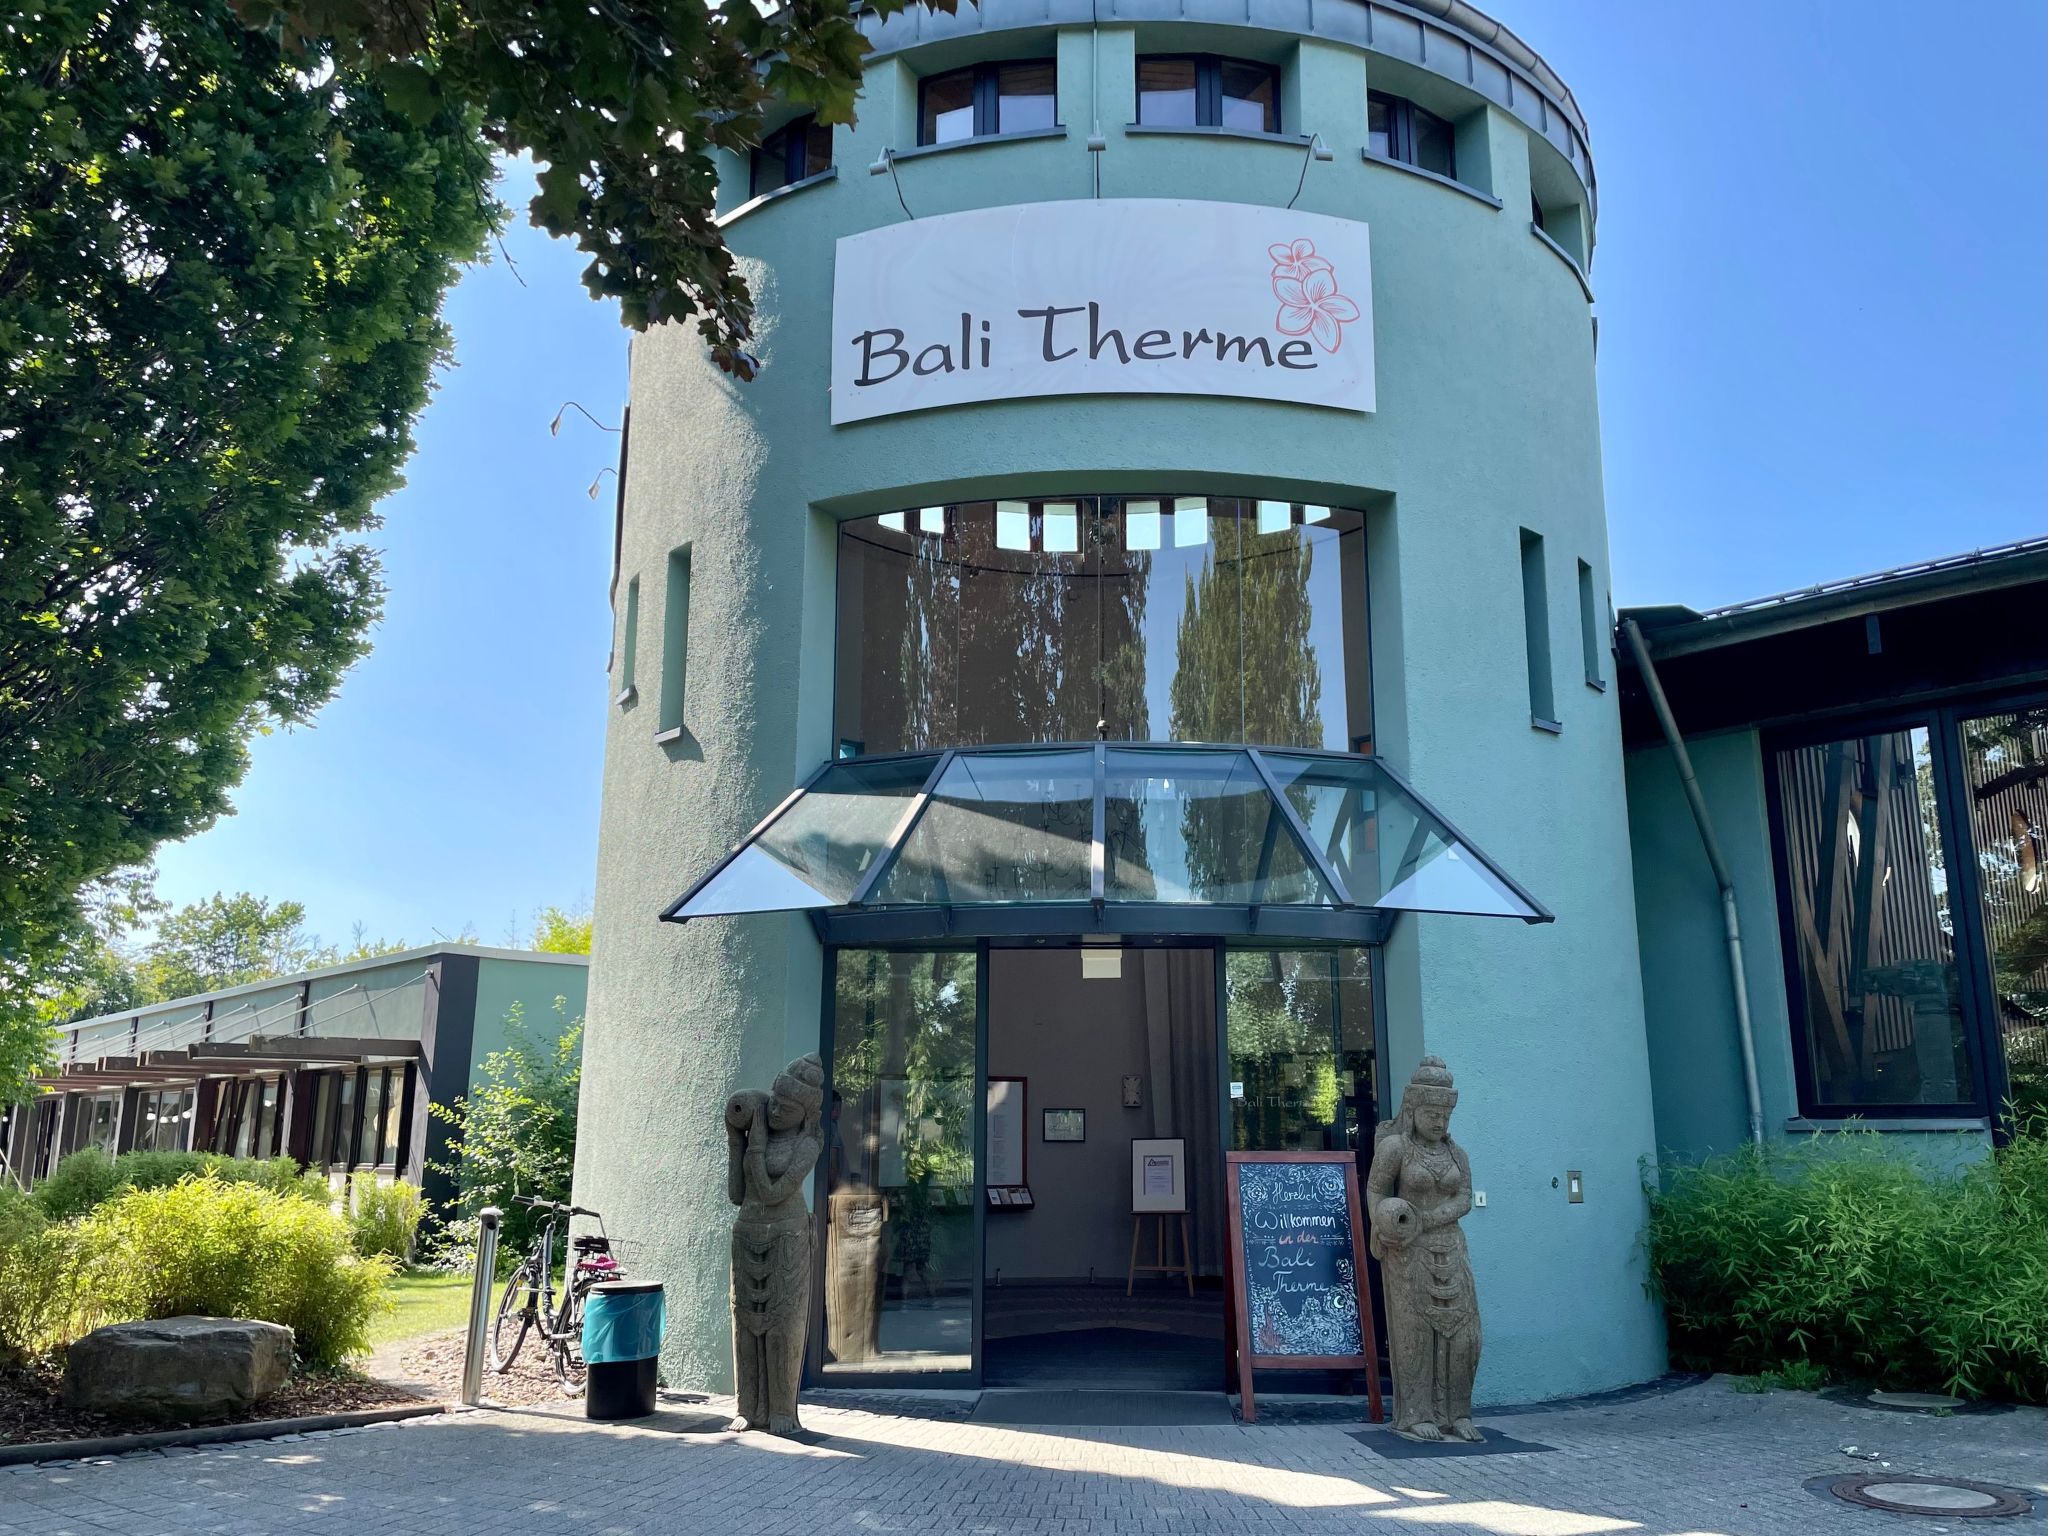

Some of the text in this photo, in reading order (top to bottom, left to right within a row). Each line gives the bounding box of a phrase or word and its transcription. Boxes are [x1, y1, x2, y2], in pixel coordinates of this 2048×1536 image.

[852, 301, 1318, 387] Bali Therme
[1272, 1181, 1321, 1205] Herzlich
[1255, 1211, 1336, 1230] Willkommen
[1278, 1230, 1319, 1245] in der
[1258, 1245, 1317, 1269] Bali
[1272, 1270, 1330, 1294] Therme
